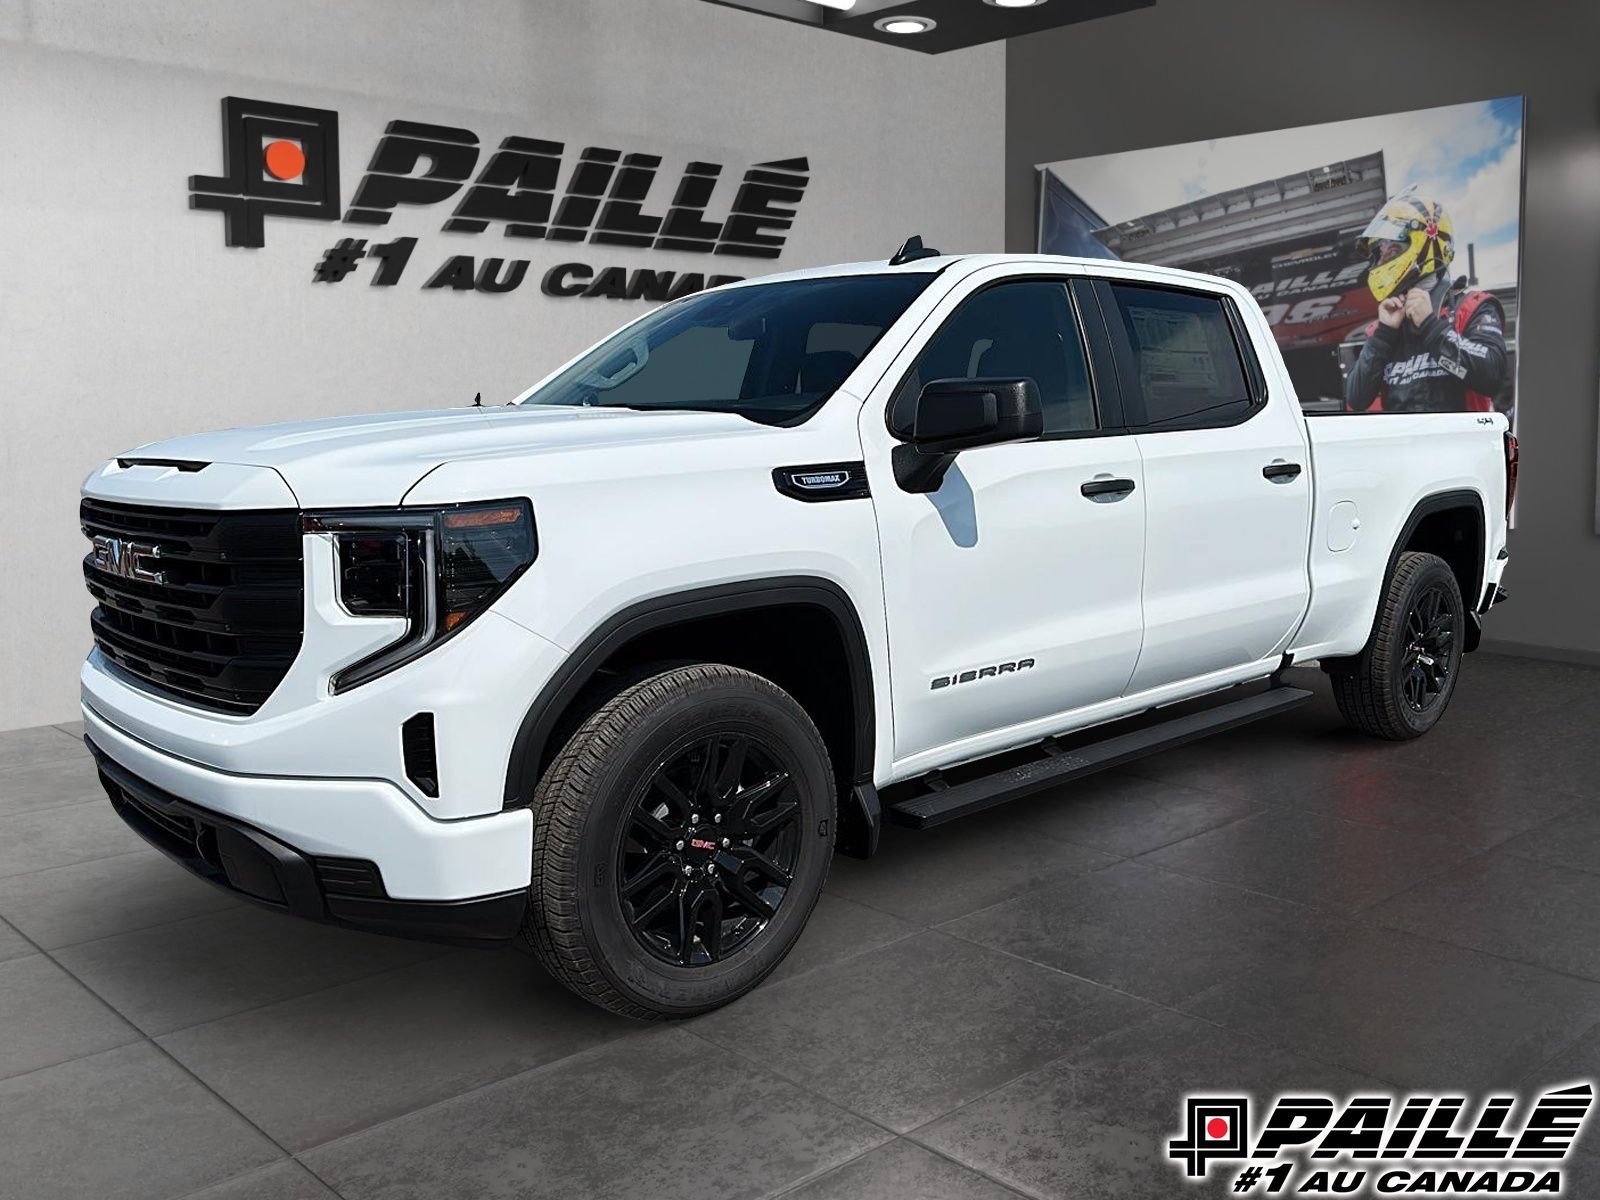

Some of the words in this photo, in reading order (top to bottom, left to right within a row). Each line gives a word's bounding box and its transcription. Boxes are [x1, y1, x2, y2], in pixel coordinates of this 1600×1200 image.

[342, 119, 809, 258] PAILLÉ
[312, 237, 418, 286] #1
[421, 255, 530, 293] AU
[801, 474, 841, 485] TURBOMAX
[93, 534, 164, 585] GMC
[930, 658, 1035, 690] SIERRA
[691, 838, 716, 850] GMC
